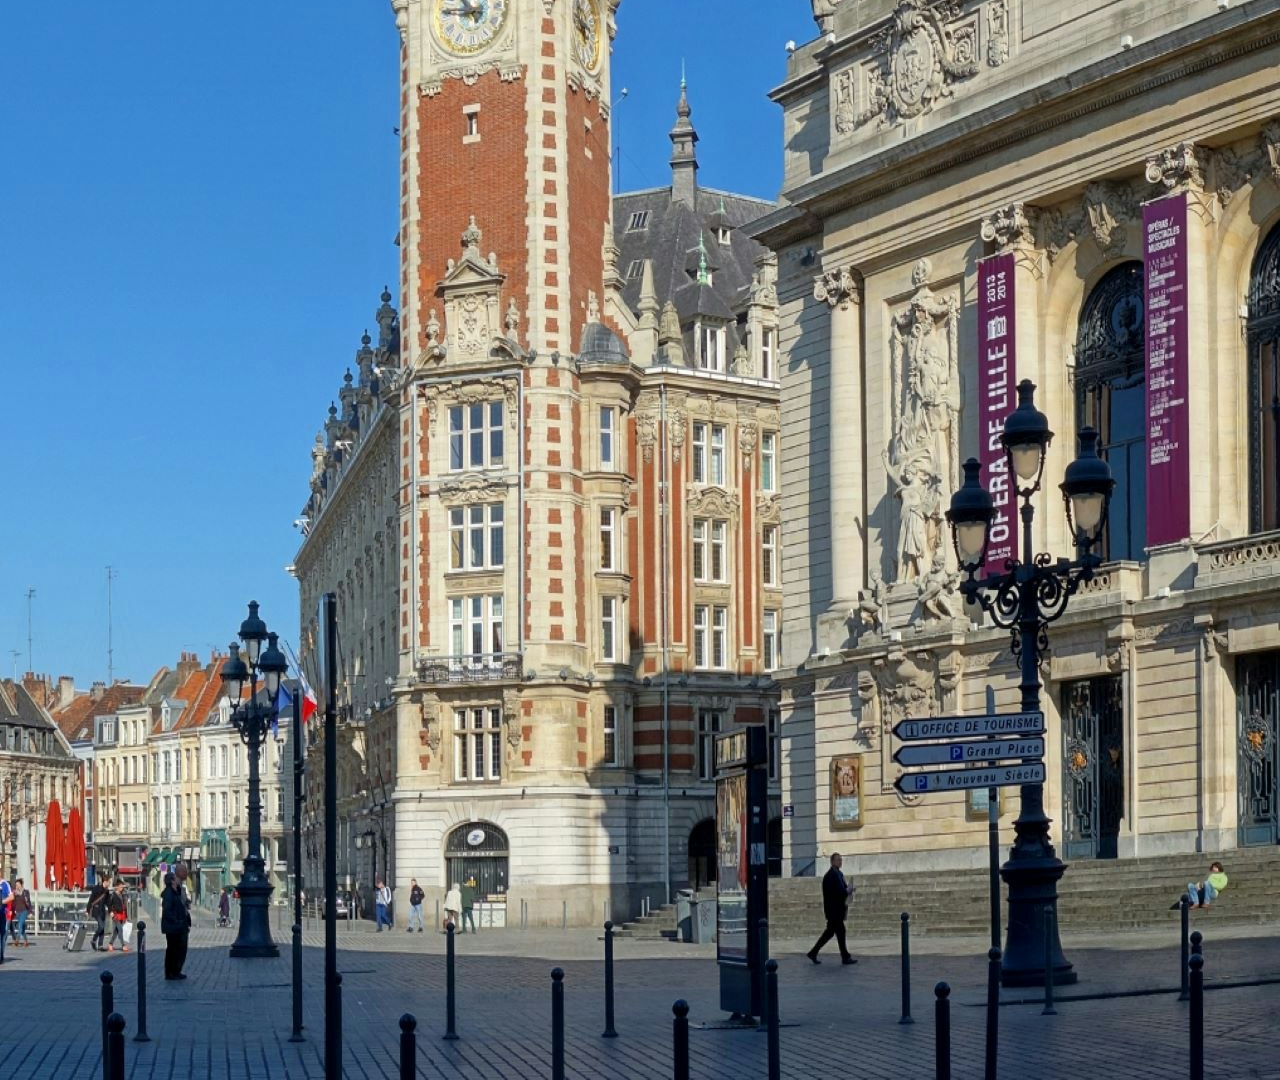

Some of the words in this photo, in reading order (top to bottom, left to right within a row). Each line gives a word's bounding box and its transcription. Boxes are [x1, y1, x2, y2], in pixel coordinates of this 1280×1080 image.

[986, 275, 996, 303] 2013
[996, 272, 1007, 300] 2014
[988, 344, 1008, 411] LILLE
[988, 416, 1007, 451] DE
[921, 722, 959, 735] OFFICE
[964, 721, 979, 732] DE
[984, 717, 1040, 731] TOURISME
[967, 745, 1001, 757] Grand
[1007, 743, 1040, 754] Place
[947, 773, 996, 785] Nouveau
[1004, 768, 1040, 781] Siècle
